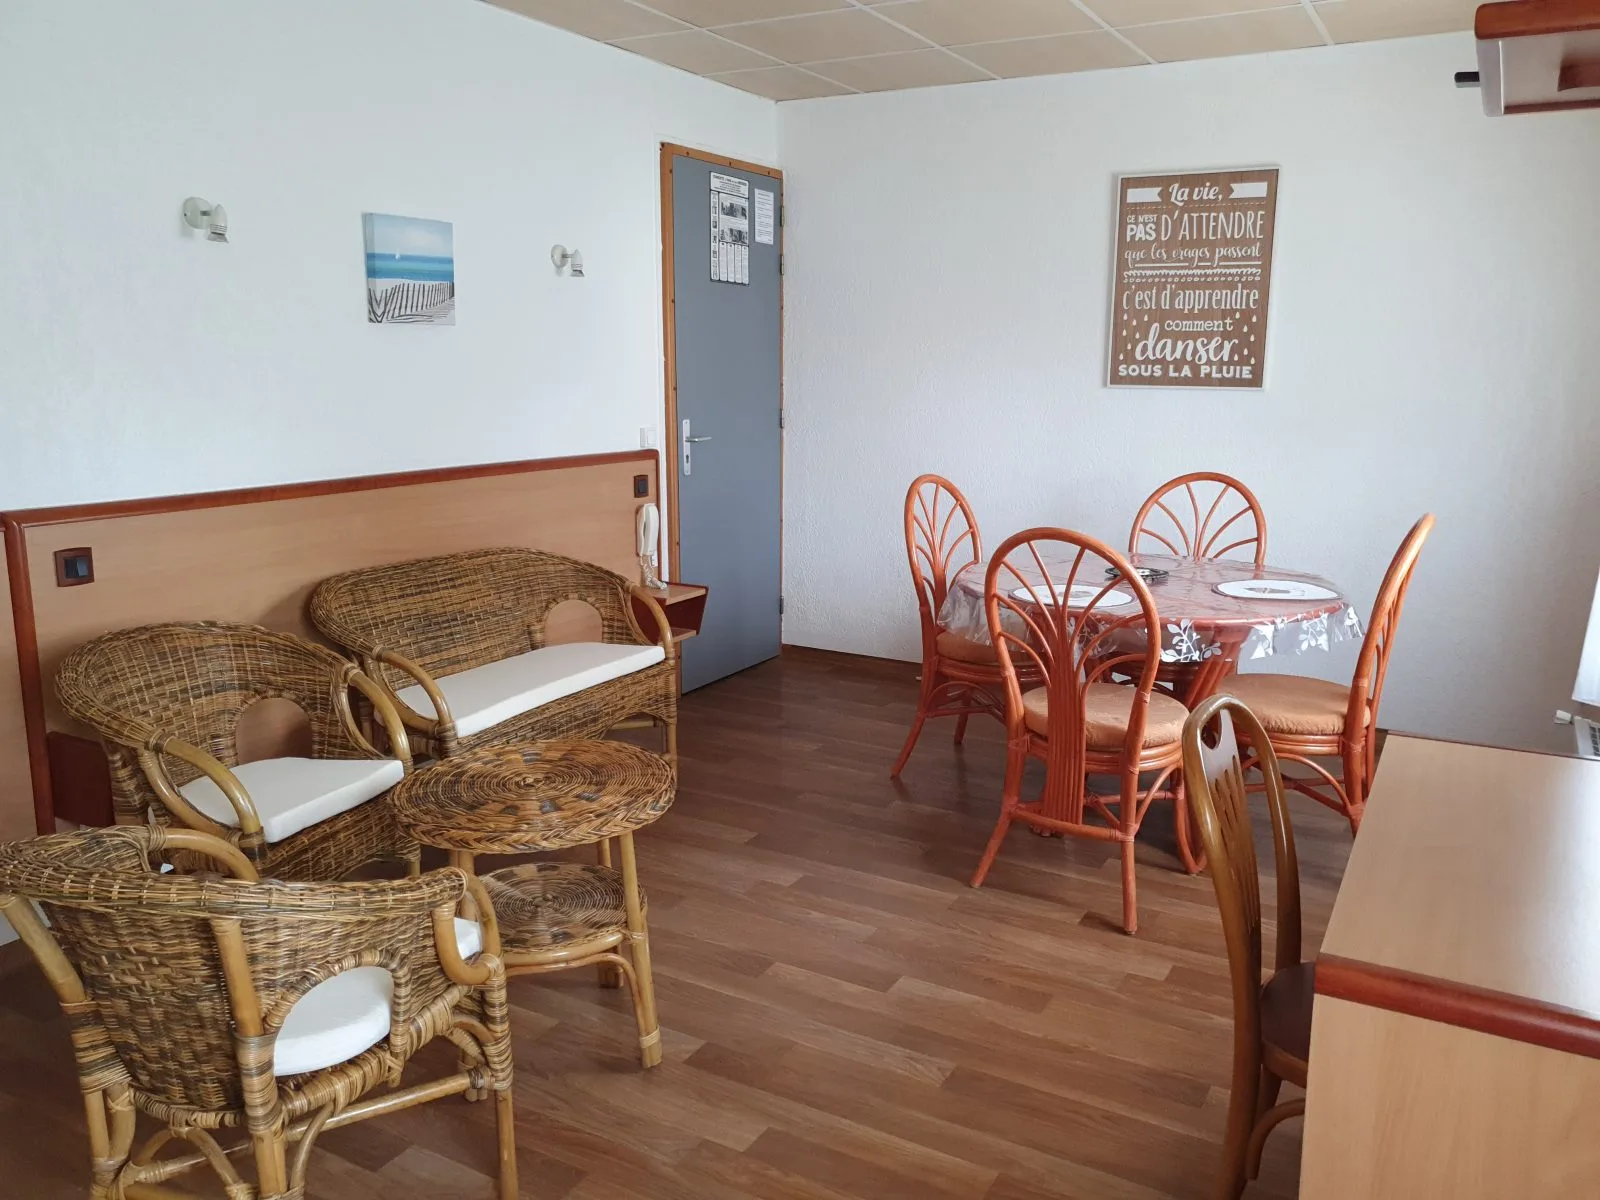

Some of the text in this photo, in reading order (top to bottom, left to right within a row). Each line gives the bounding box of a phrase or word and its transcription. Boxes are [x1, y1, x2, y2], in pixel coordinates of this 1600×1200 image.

[1169, 182, 1223, 206] La vie,
[1126, 214, 1158, 223] CE N'EST
[1161, 210, 1265, 241] D'ATTENDRE
[1126, 223, 1156, 242] PAS
[1125, 249, 1147, 267] que
[1150, 244, 1167, 260] les
[1215, 242, 1263, 267] passent
[1123, 283, 1259, 314] c'est d'apprendre
[1164, 316, 1234, 332] comment
[1118, 363, 1253, 379] SOUS LA PLUIE
